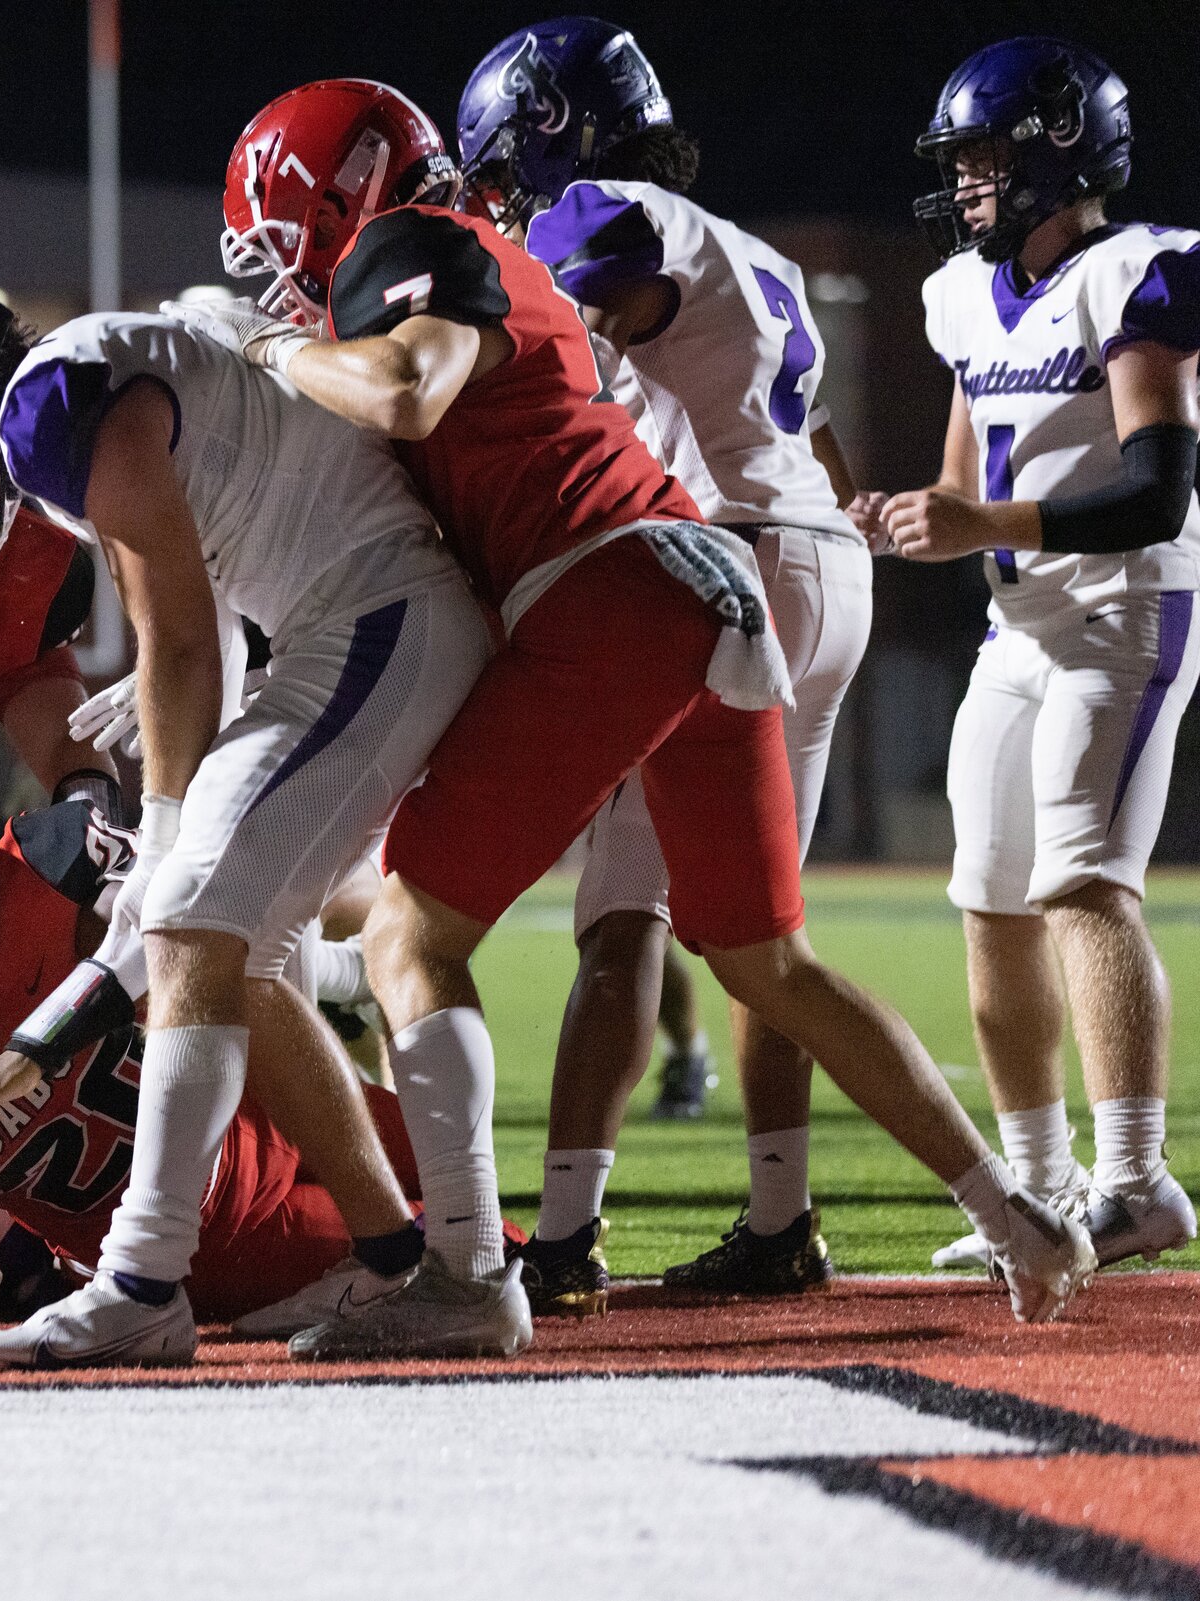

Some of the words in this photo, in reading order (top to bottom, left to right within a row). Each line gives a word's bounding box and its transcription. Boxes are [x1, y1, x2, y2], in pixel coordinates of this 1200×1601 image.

[278, 152, 315, 189] 7
[383, 272, 432, 313] 7
[750, 263, 816, 435] 2
[955, 346, 1106, 400] Fyetteville
[986, 424, 1018, 584] 1
